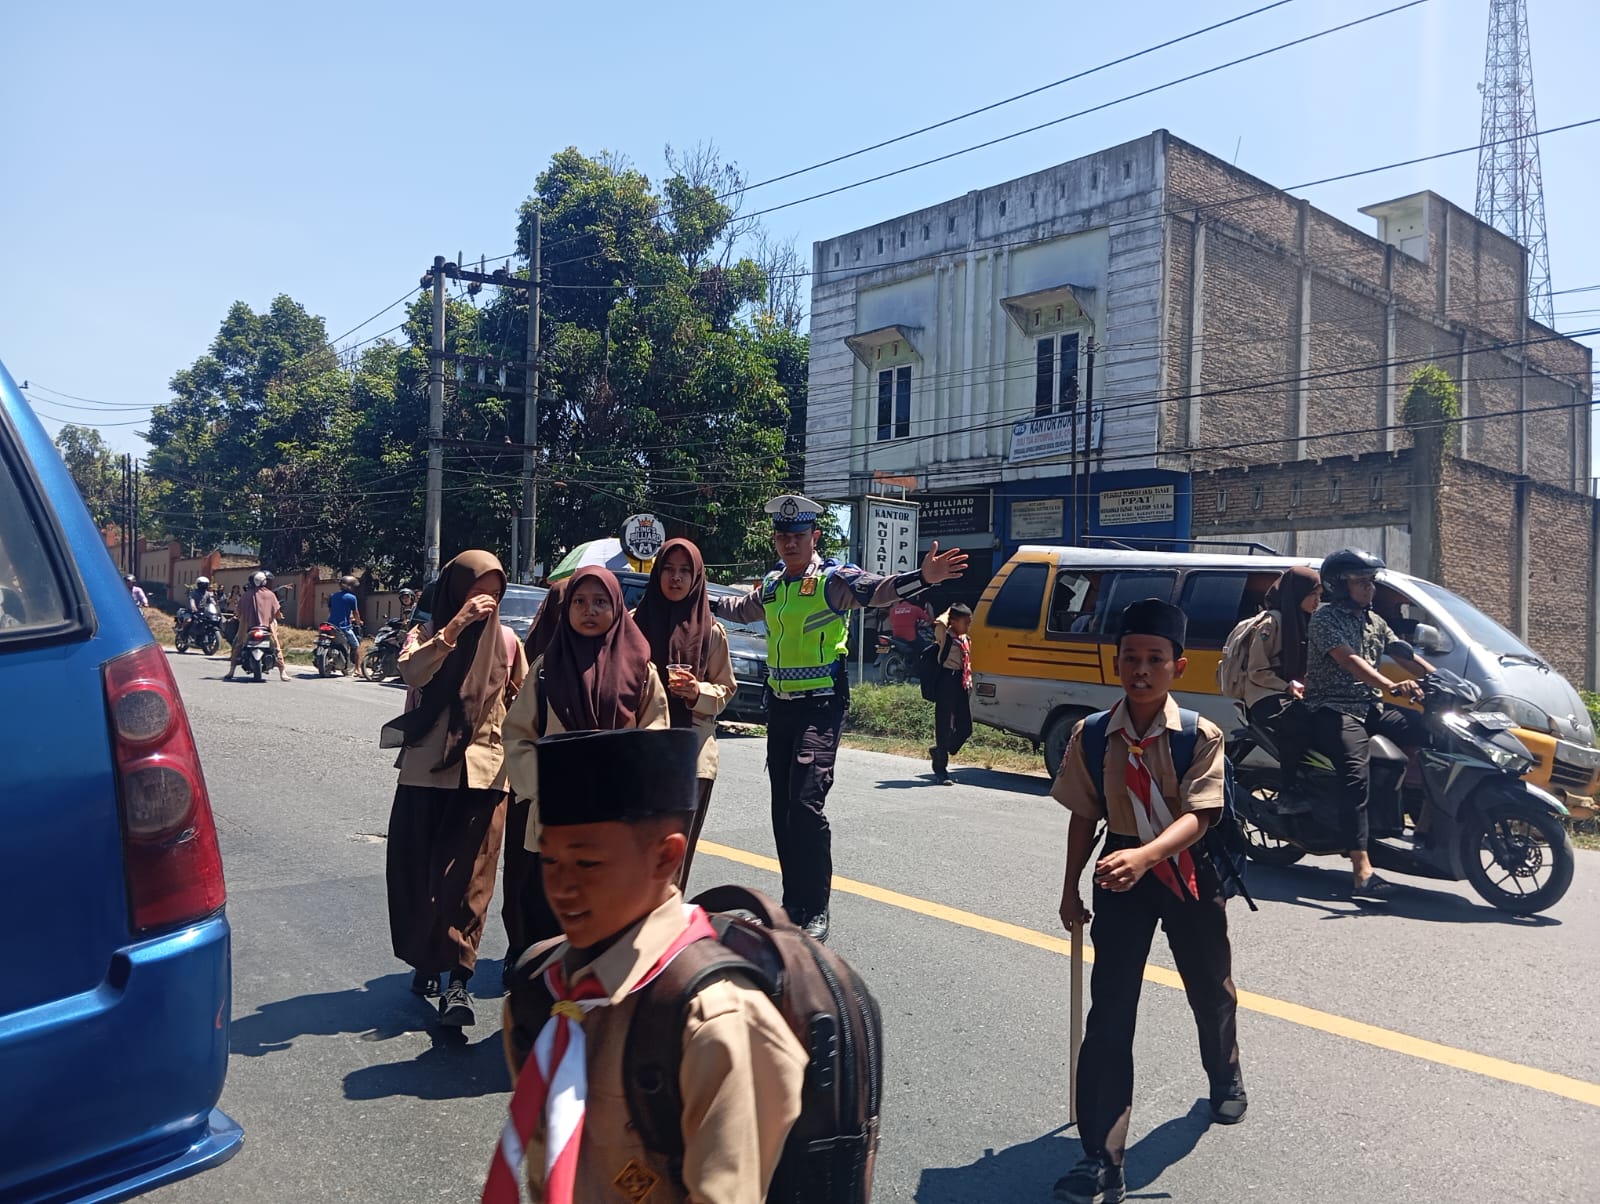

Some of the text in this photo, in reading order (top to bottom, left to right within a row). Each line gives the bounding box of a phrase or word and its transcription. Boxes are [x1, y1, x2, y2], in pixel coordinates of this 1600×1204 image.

[1029, 418, 1056, 435] KANTOR
[1057, 412, 1083, 429] HUKM
[933, 498, 974, 508] BILLIARD
[875, 509, 910, 521] KANTOR
[918, 507, 974, 518] LAYSTATION
[630, 532, 661, 542] BILLIARD
[898, 527, 909, 574] PPA
